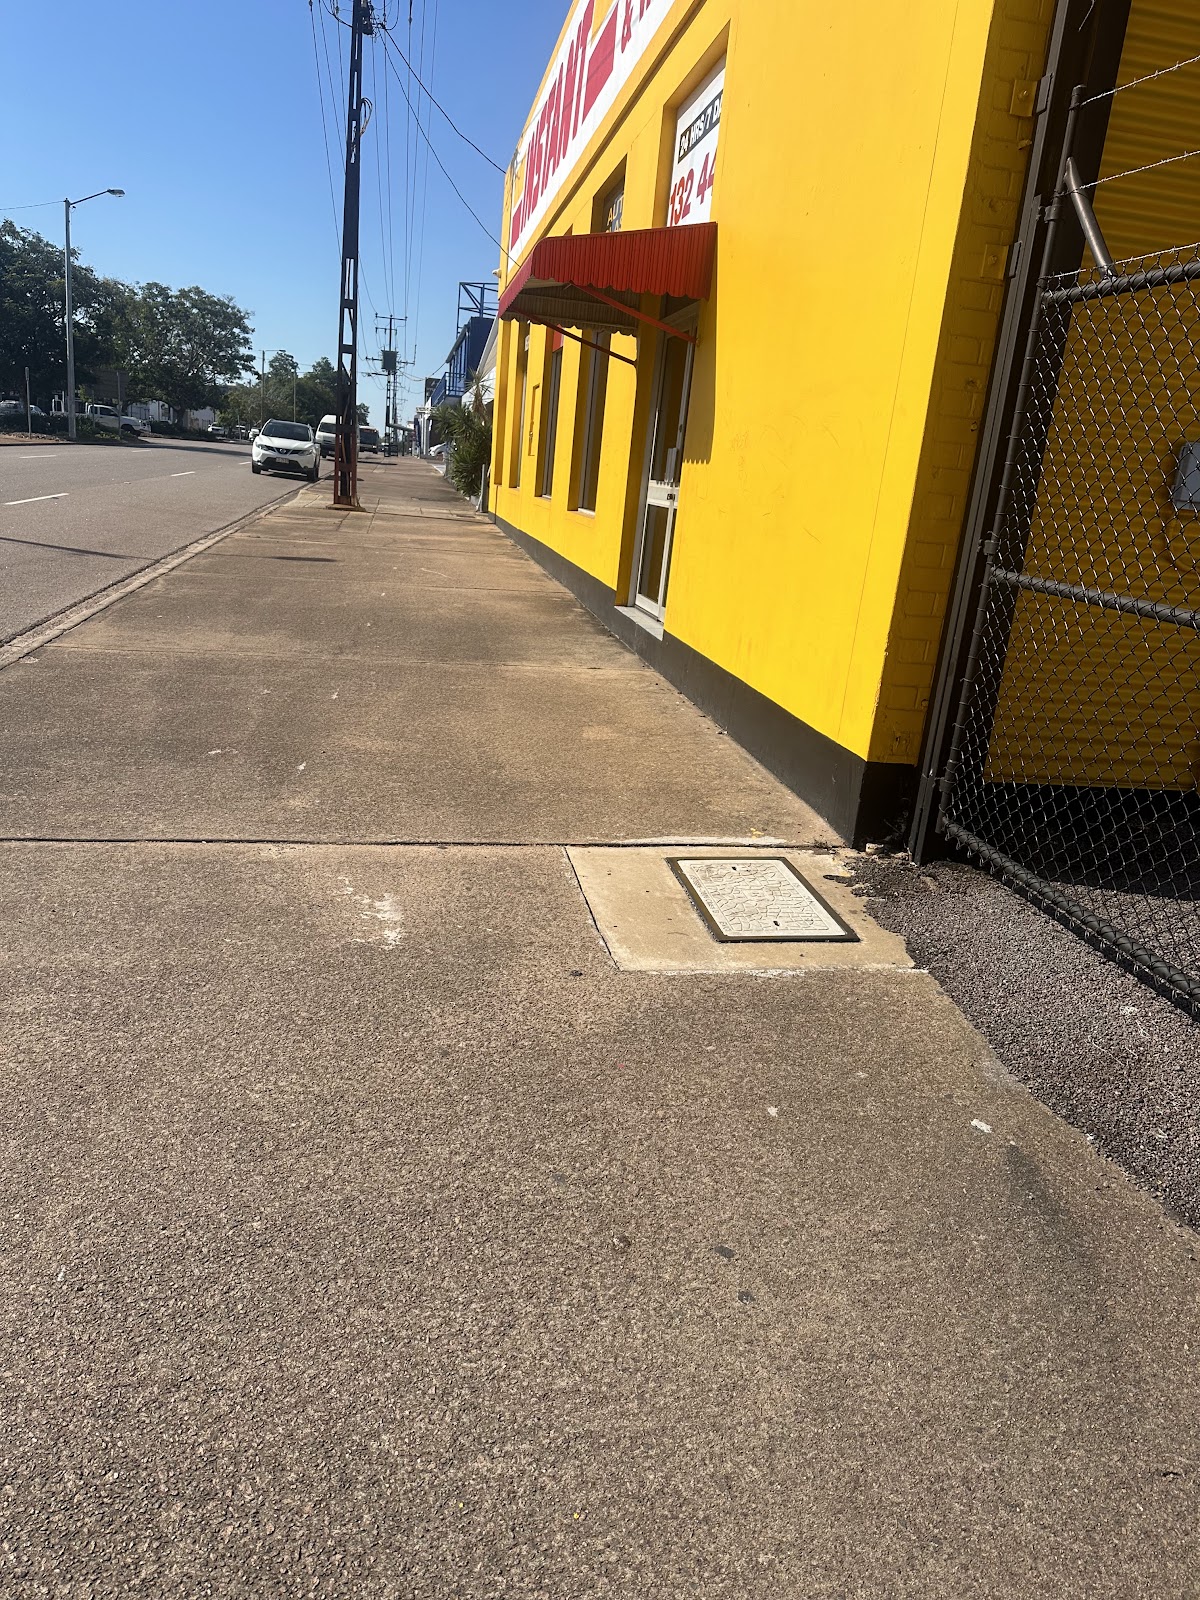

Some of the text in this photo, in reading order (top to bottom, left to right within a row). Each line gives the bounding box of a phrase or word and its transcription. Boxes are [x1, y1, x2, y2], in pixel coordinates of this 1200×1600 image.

[521, 0, 594, 233] INSTANT
[679, 130, 690, 158] 24
[669, 168, 694, 227] 132
